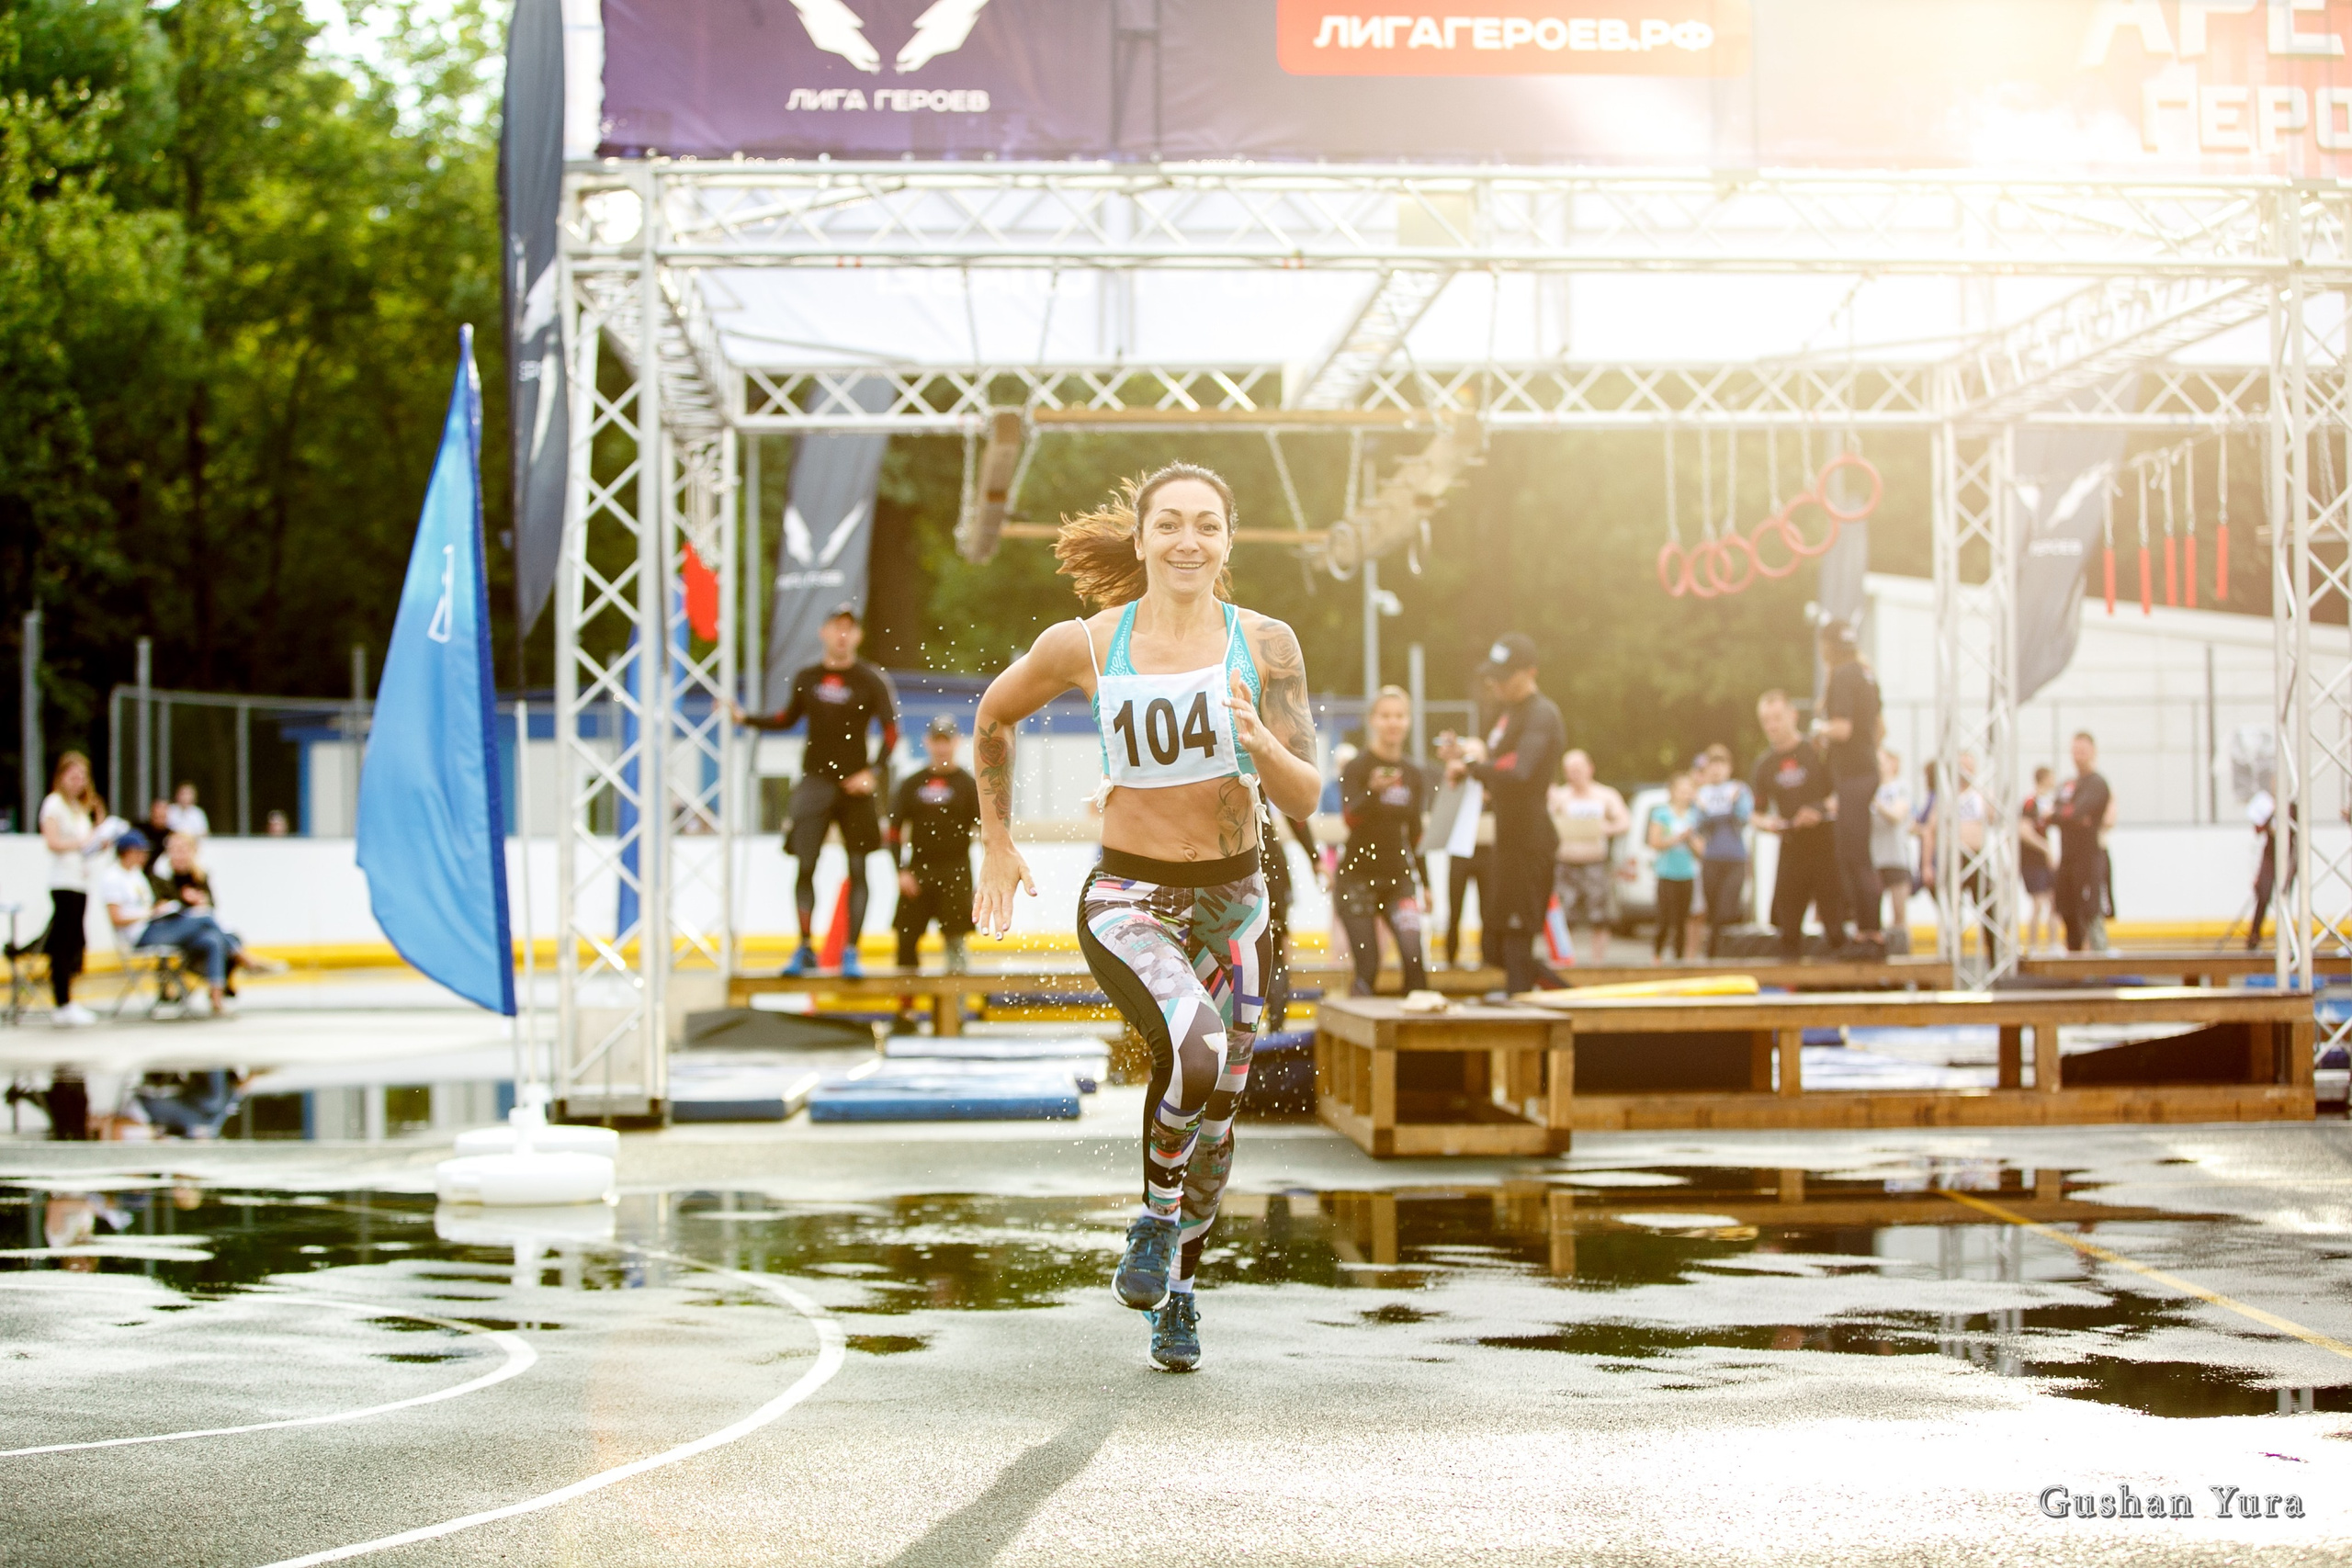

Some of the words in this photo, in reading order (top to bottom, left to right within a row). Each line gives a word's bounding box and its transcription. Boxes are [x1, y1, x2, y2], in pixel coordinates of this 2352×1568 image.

[1313, 15, 1714, 51] ЛИГАГЕРОЕВ.РФ
[785, 88, 868, 111] ЛИГА
[874, 89, 990, 112] ГЕРОЕВ
[1113, 691, 1217, 767] 104
